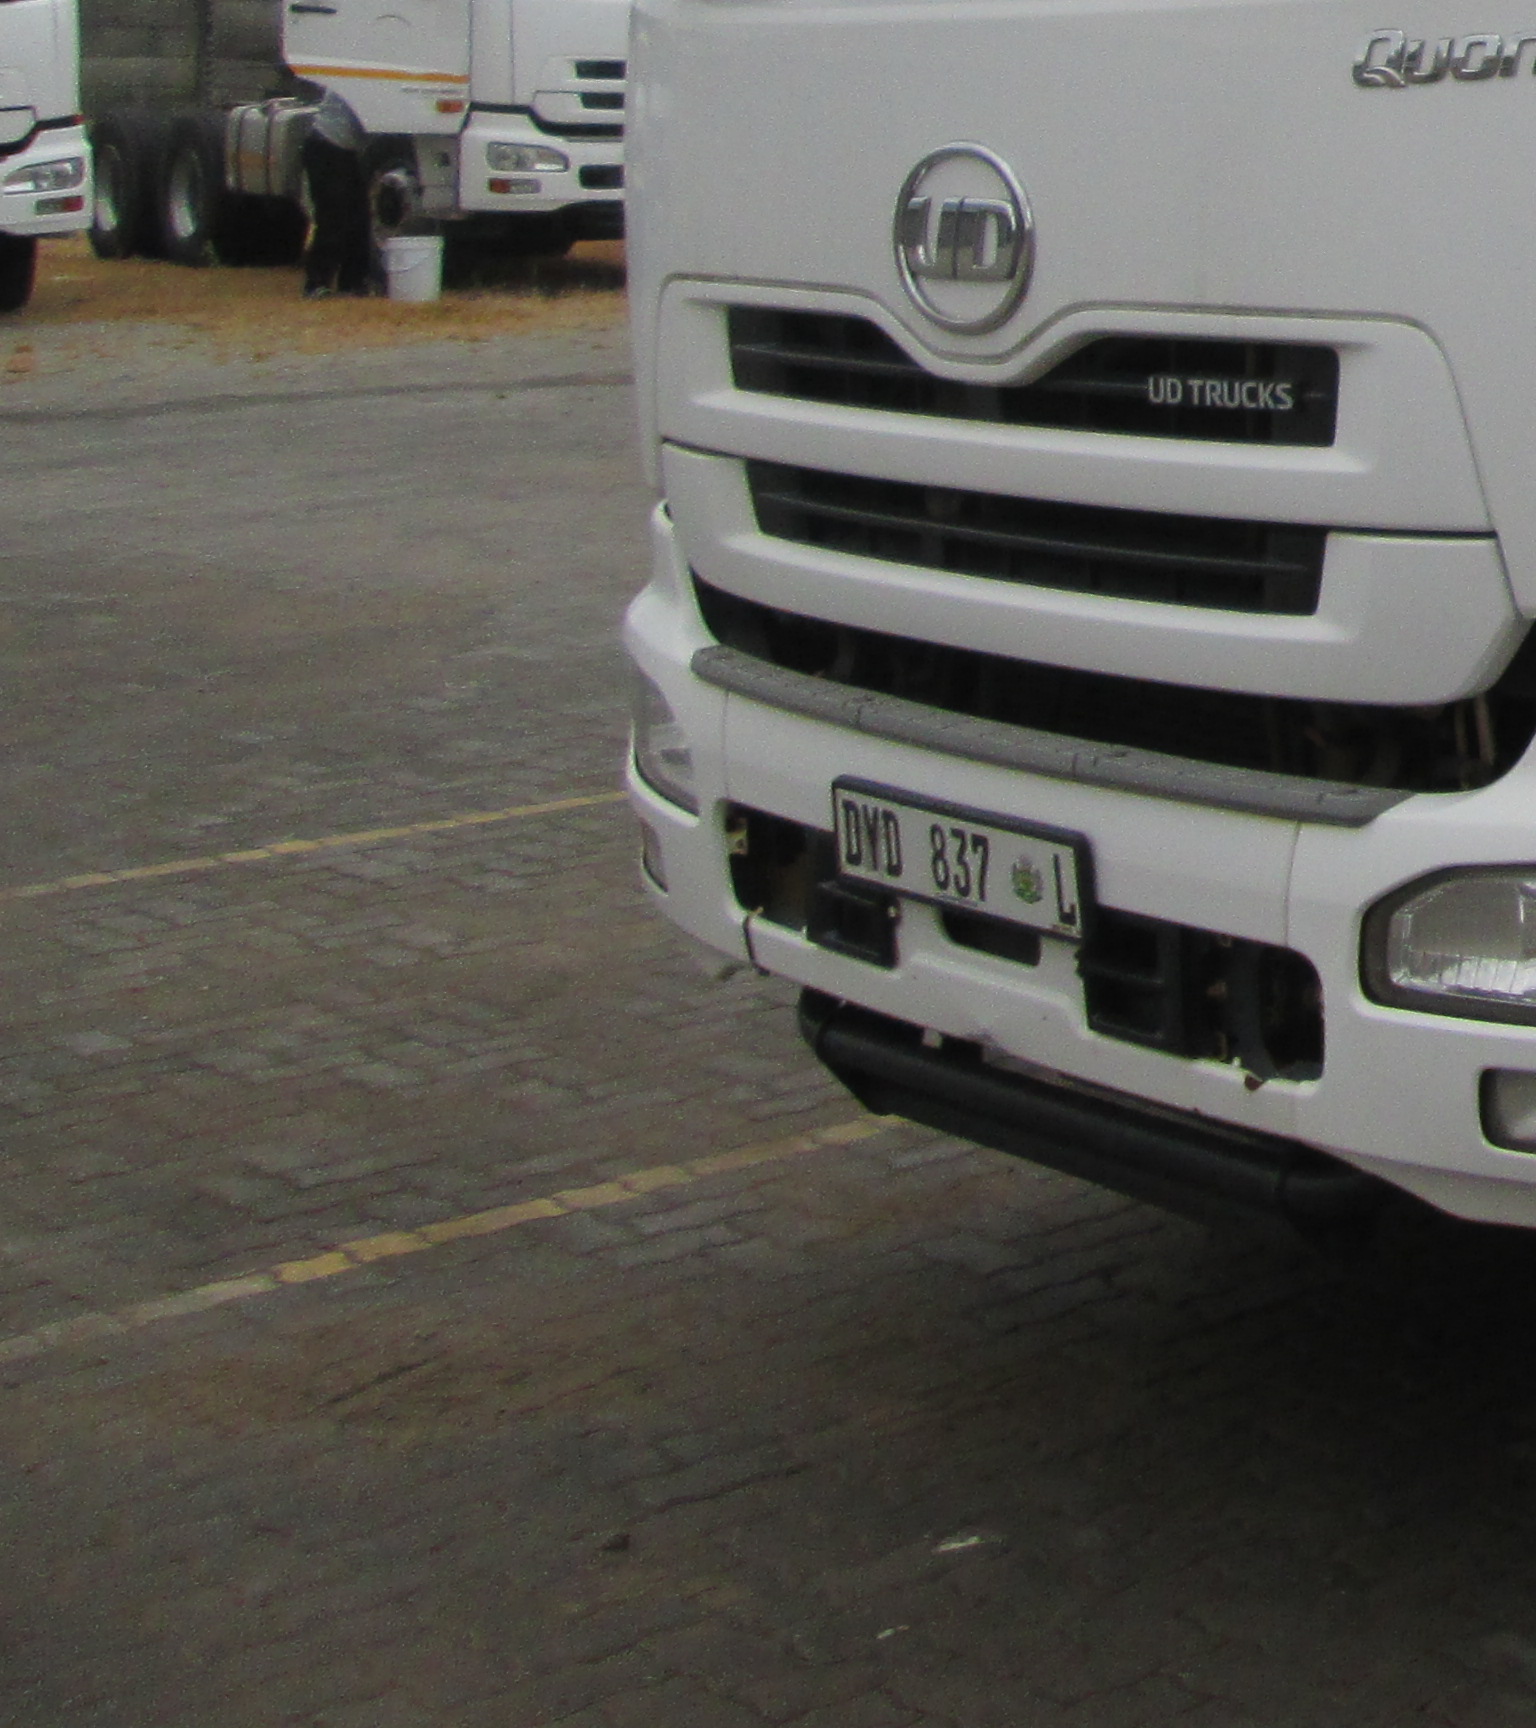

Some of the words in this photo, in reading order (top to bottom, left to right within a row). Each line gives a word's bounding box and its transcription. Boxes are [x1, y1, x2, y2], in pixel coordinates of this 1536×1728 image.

[900, 196, 1019, 280] UD
[1148, 376, 1182, 405] UD
[1188, 379, 1293, 409] TRUCKS
[844, 801, 902, 877] DYD
[931, 823, 989, 901] 837
[1053, 854, 1076, 925] L
